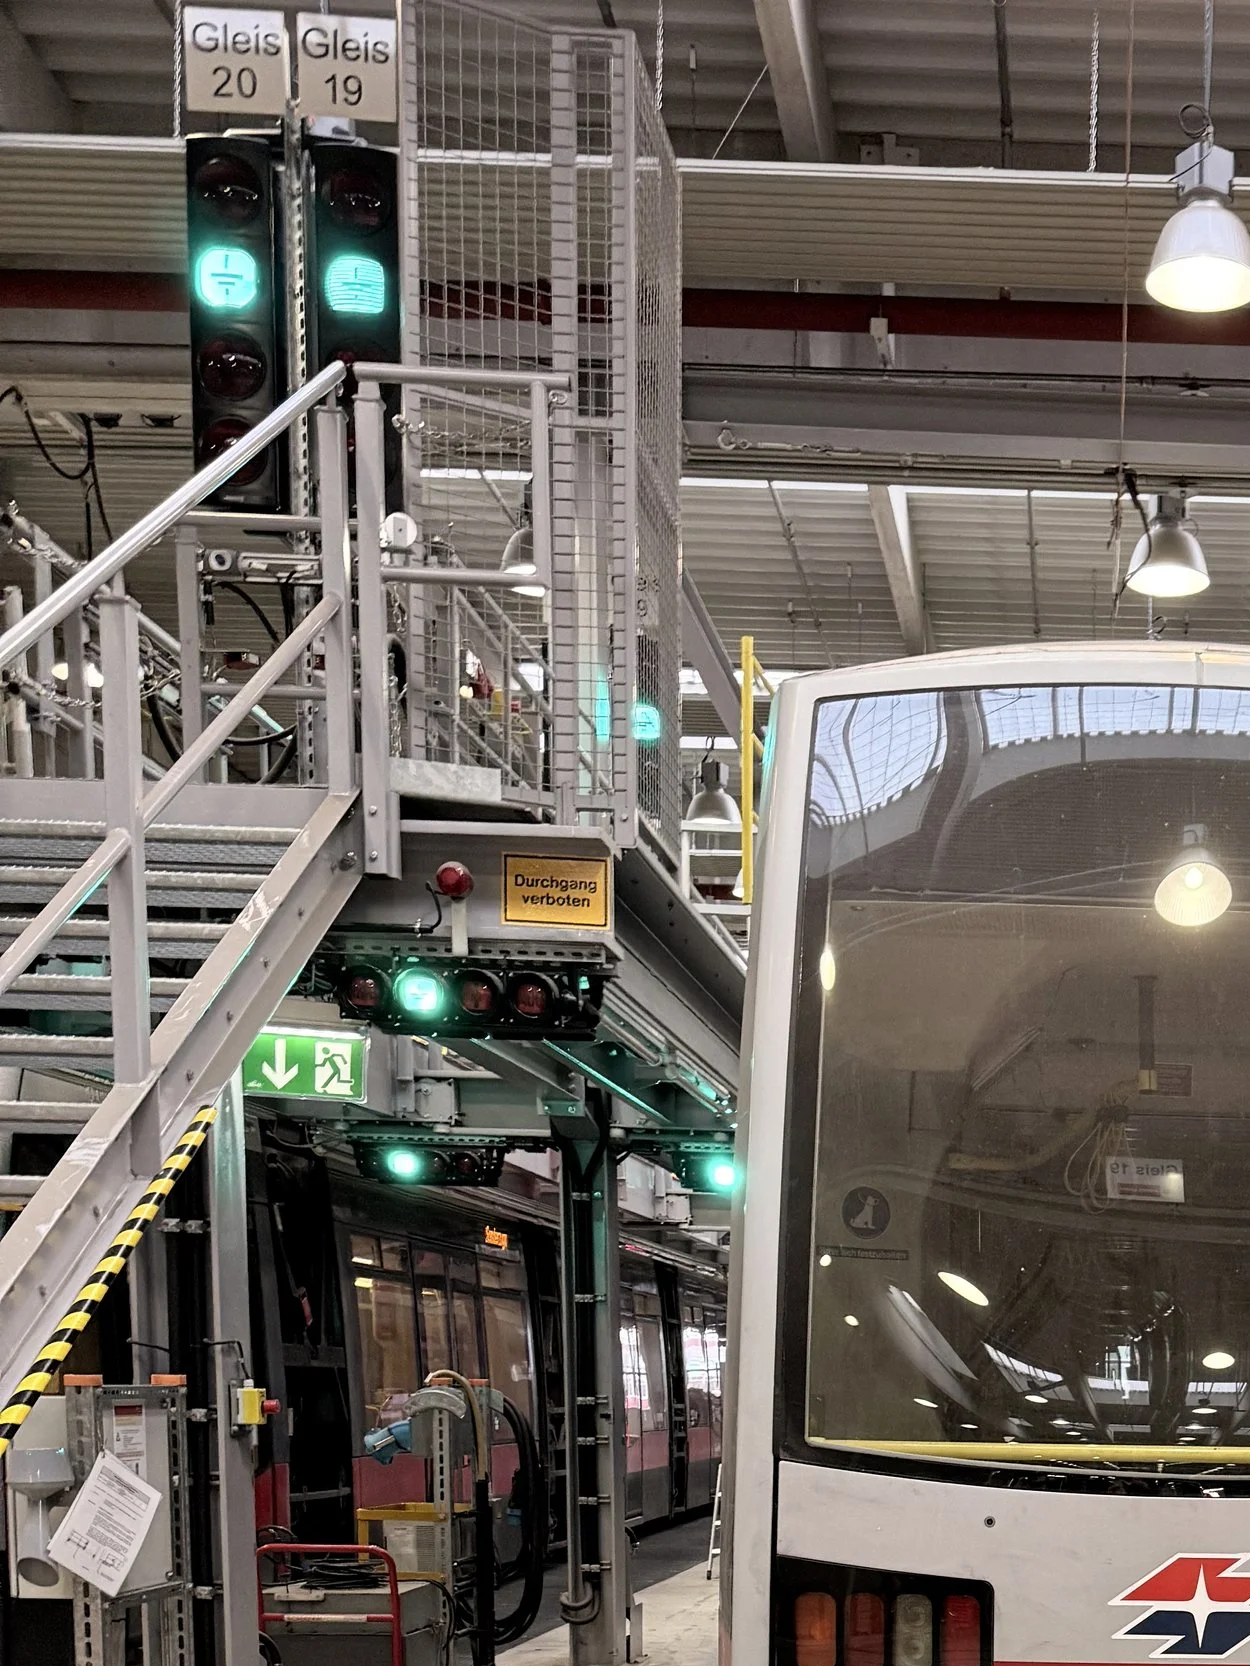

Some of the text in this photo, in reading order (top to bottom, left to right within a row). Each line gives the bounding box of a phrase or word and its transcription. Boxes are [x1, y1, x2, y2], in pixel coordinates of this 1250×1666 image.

[192, 21, 281, 57] Gleis
[301, 27, 390, 64] Gleis
[212, 66, 258, 98] 20
[325, 73, 363, 106] 19
[514, 873, 597, 894] Durchgang
[522, 893, 590, 908] verboten
